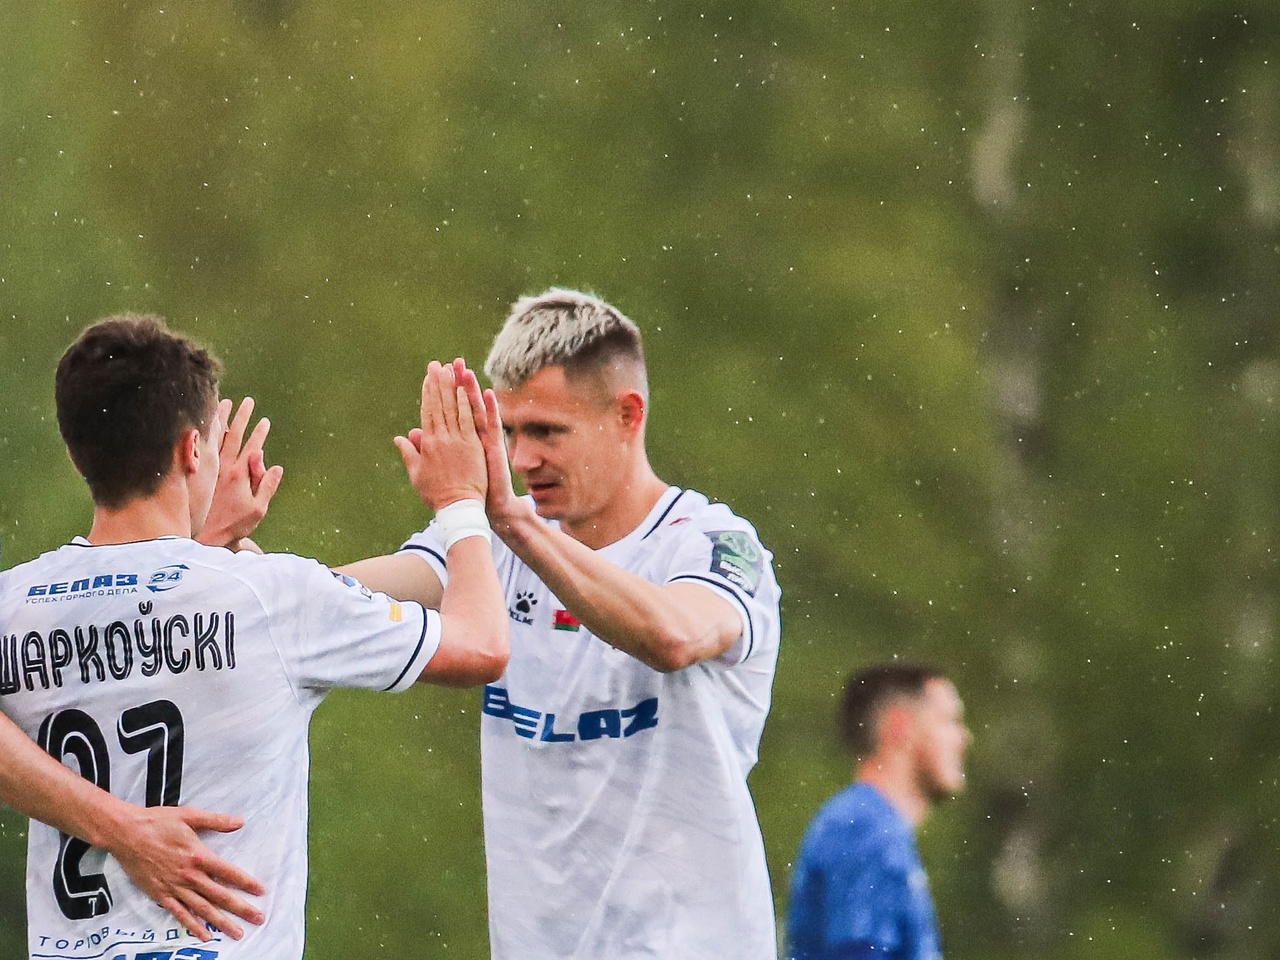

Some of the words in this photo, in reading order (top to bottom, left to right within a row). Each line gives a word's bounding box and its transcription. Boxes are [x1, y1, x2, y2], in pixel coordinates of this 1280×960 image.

[27, 574, 138, 597] БЕЛАЗ
[59, 590, 105, 602] ГОРНОГО
[107, 587, 138, 596] ДЕЛА
[482, 684, 659, 742] BELAZ
